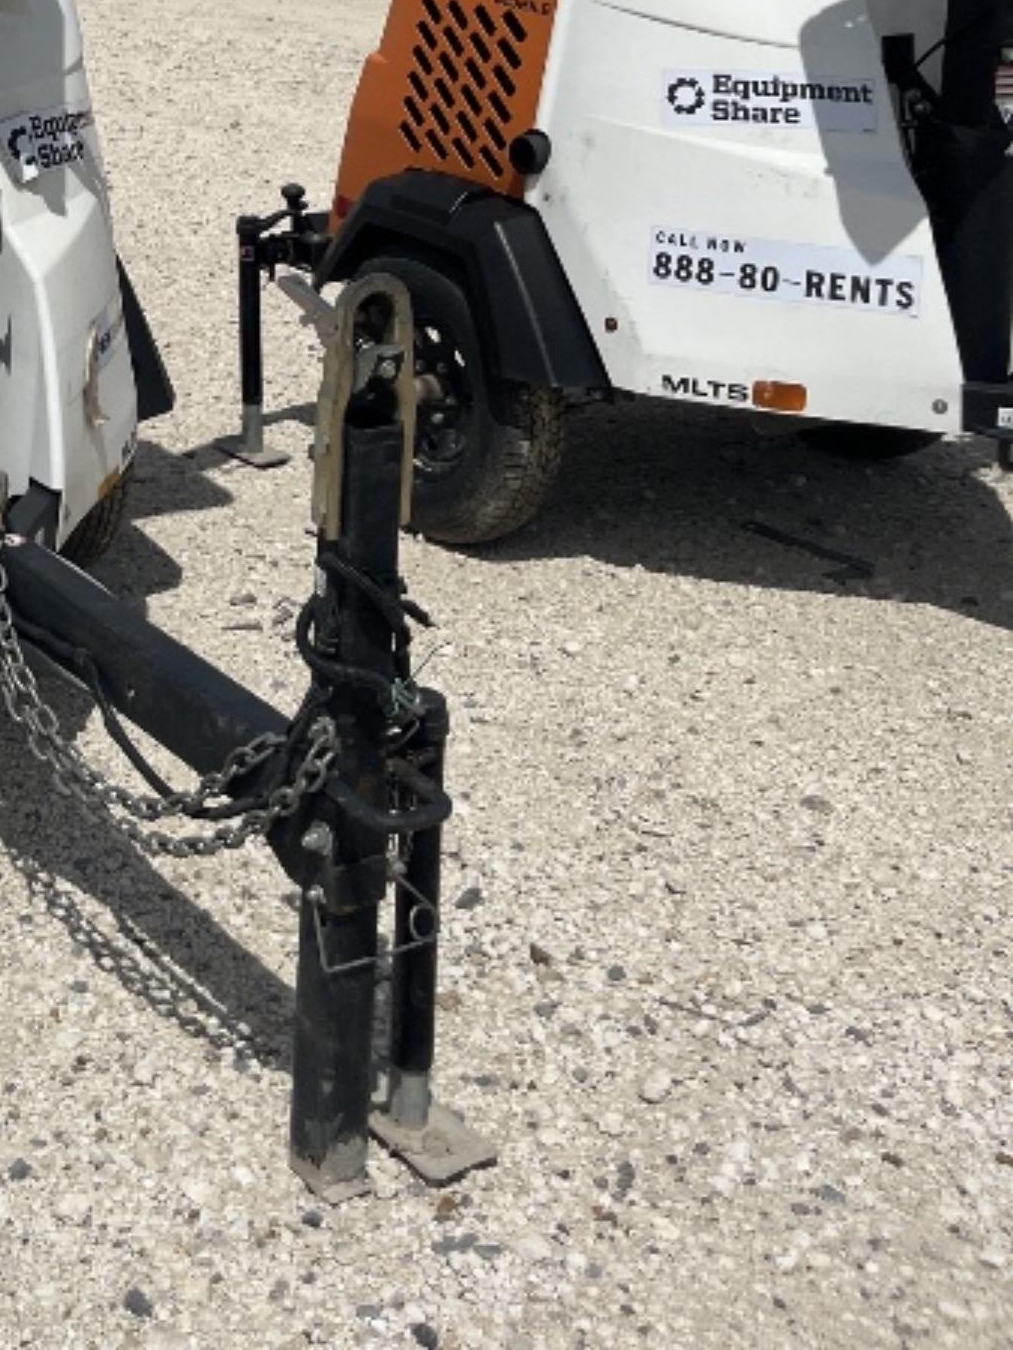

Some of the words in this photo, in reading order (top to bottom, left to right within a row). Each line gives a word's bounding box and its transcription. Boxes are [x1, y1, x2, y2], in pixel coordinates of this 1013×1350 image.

[711, 73, 874, 104] Equipment
[711, 99, 801, 124] Share
[661, 373, 750, 403] MLTS
